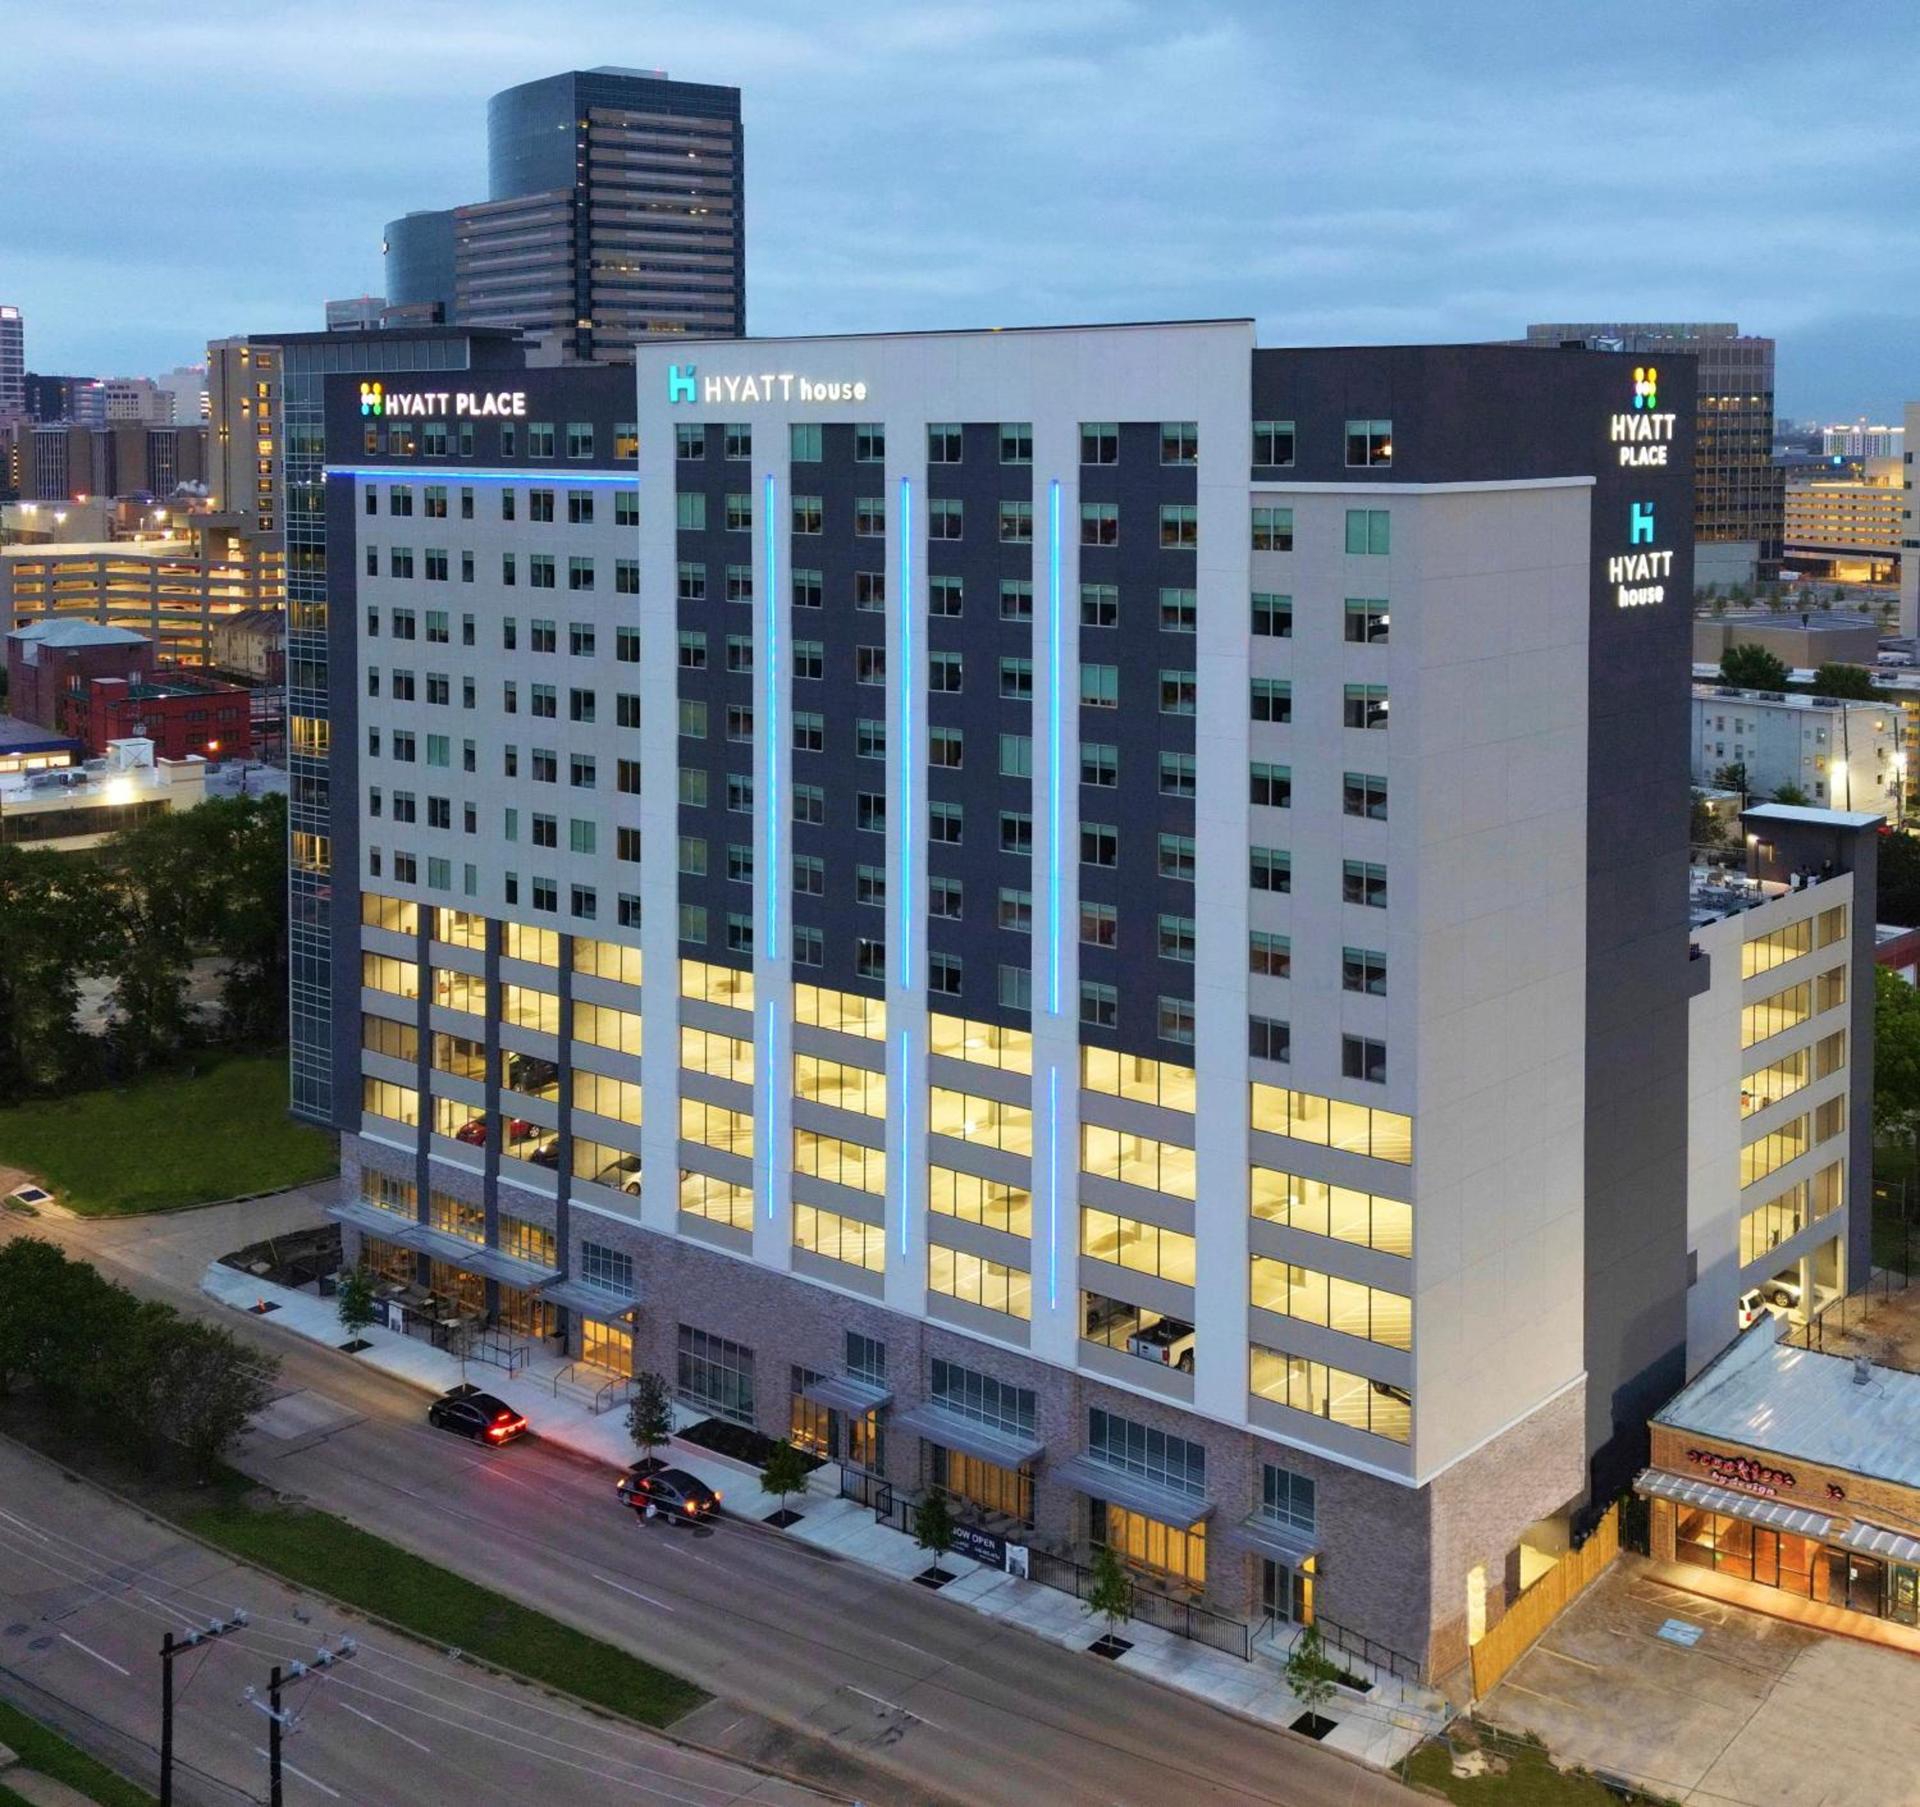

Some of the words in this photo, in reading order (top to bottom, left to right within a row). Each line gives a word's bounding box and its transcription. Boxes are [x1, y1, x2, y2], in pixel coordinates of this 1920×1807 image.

[704, 374, 795, 403] HYATT
[800, 378, 868, 401] house
[384, 393, 450, 416] HYATT
[456, 391, 527, 416] PLACE
[1611, 413, 1676, 441] HYATT
[1620, 445, 1668, 467] PLACE
[1608, 550, 1674, 584] HYATT
[1618, 585, 1665, 608] house
[972, 1534, 995, 1549] OPEN
